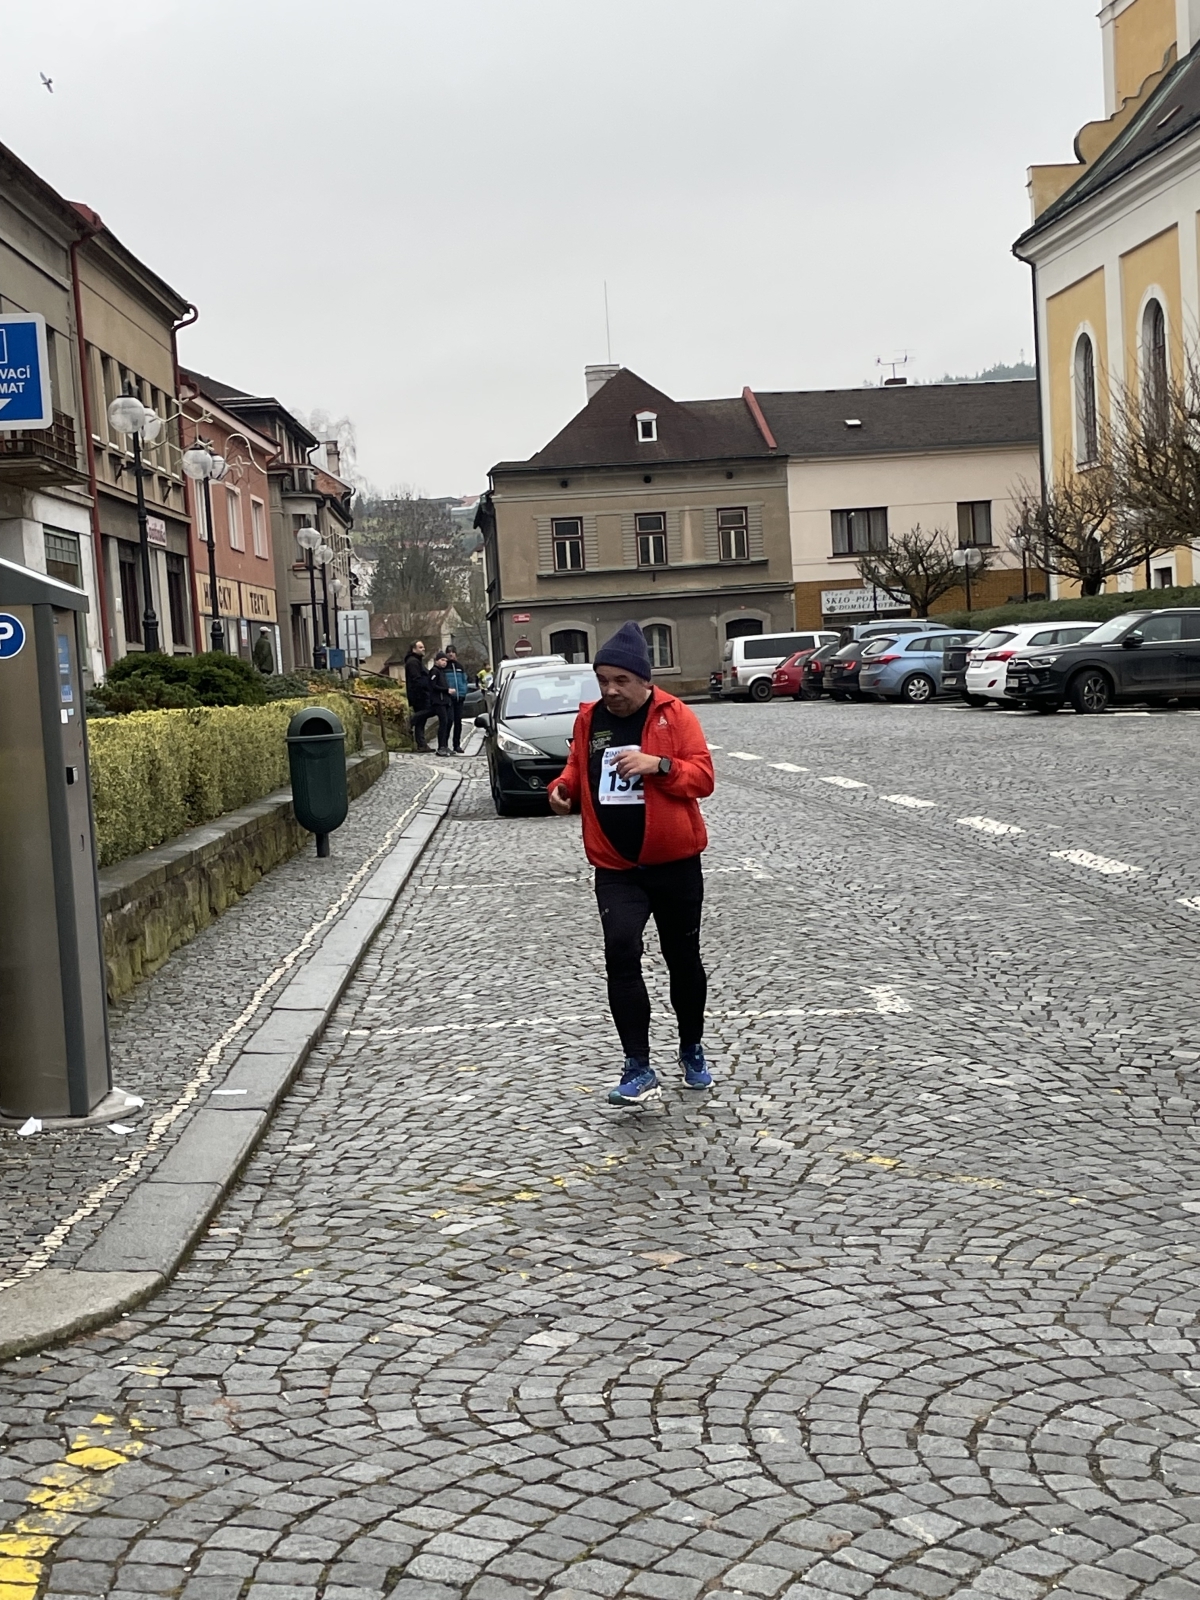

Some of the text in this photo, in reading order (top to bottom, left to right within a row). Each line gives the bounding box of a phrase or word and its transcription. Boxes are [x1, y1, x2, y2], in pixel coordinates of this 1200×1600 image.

[0, 365, 30, 379] VACÍ
[0, 382, 25, 394] MAT
[203, 579, 231, 610] HČKY
[249, 592, 270, 616] TEXTIL
[826, 596, 850, 605] SKLO
[0, 622, 14, 649] P
